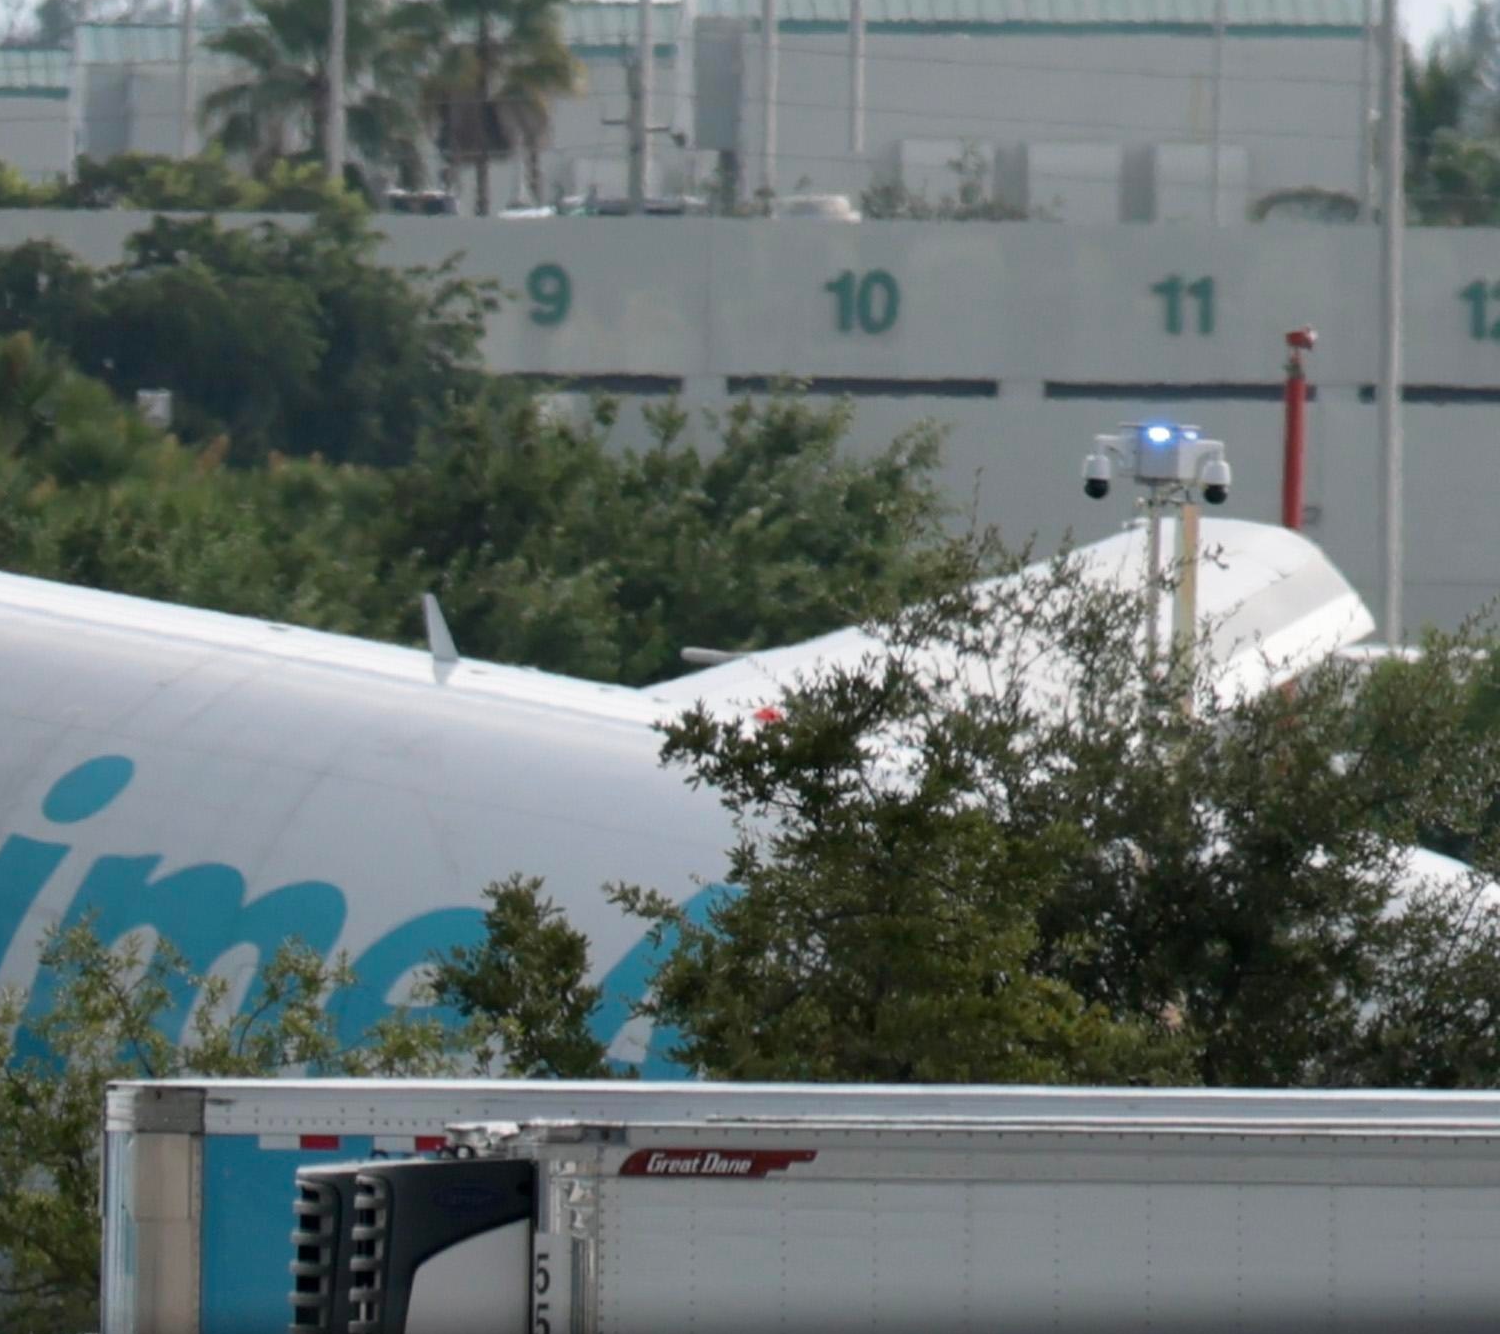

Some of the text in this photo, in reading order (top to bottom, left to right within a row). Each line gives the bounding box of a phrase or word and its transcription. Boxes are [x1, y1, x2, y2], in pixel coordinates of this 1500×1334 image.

[526, 263, 573, 326] 9
[823, 269, 901, 336] 10
[1150, 275, 1216, 336] 11
[1457, 280, 1500, 341] 1
[647, 1152, 753, 1174] Great Dane
